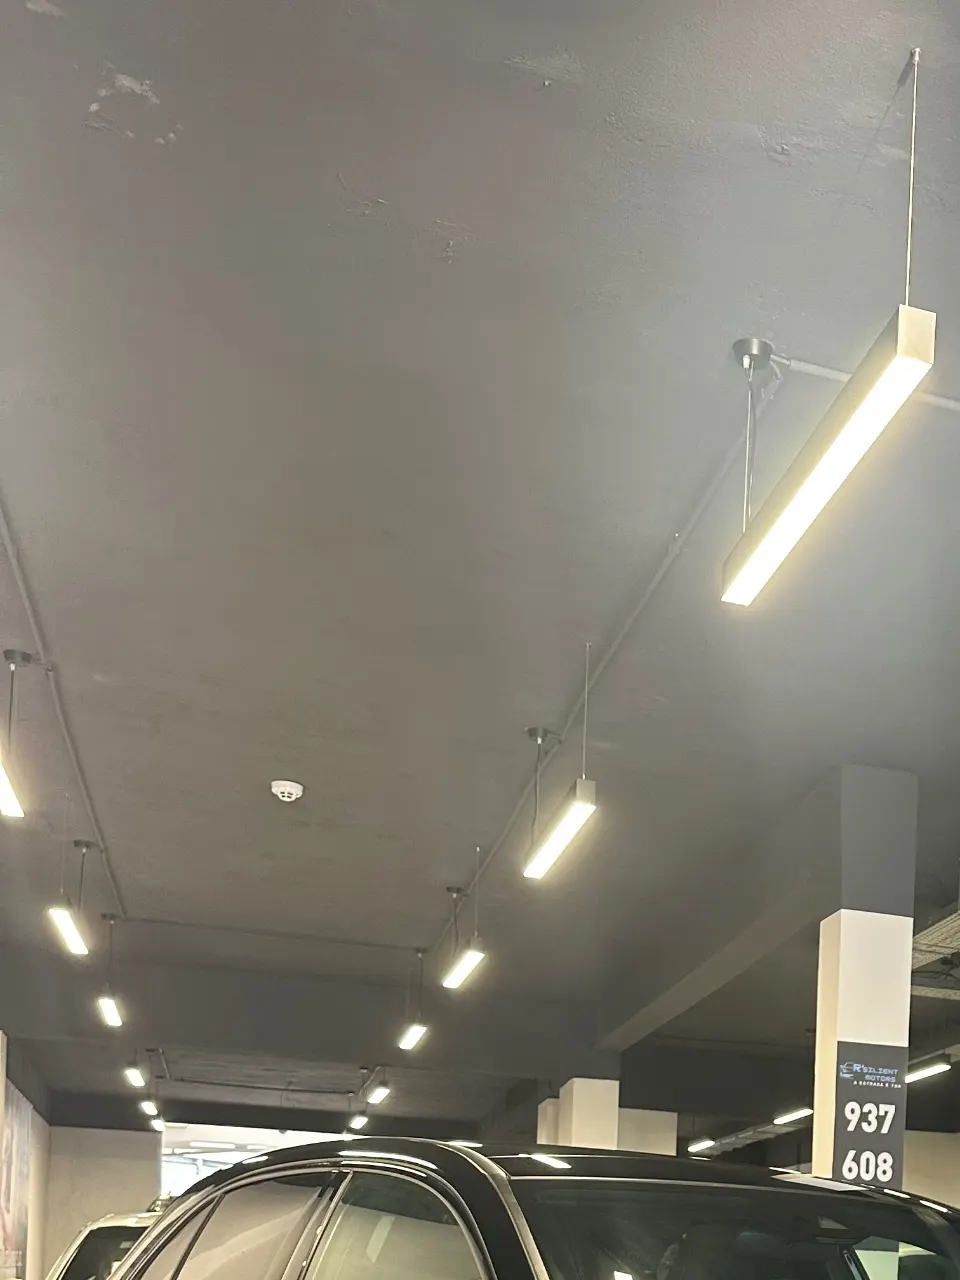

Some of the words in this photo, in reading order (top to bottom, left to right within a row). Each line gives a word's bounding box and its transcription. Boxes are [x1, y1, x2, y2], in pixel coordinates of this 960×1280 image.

[865, 1074, 896, 1083] MOTORS
[844, 1101, 896, 1134] 937
[842, 1149, 893, 1182] 608
